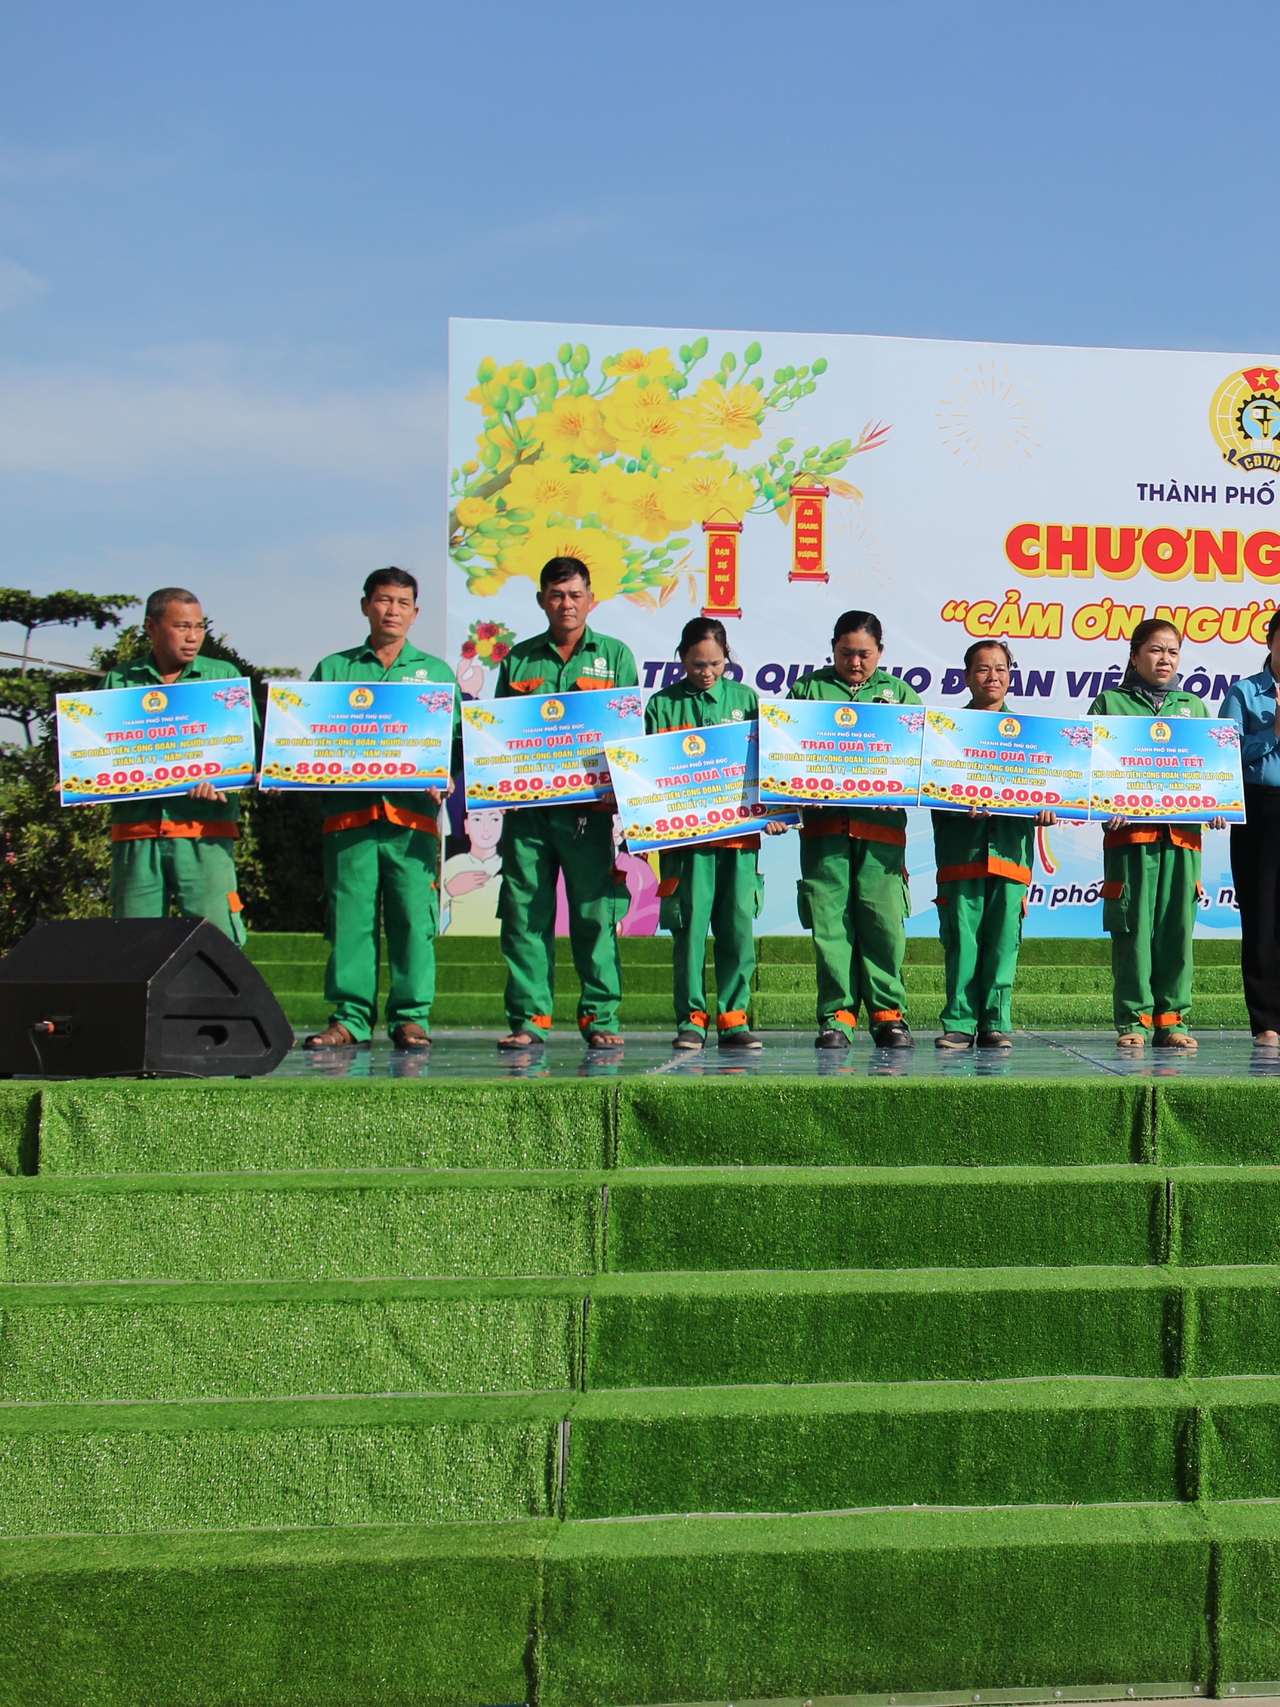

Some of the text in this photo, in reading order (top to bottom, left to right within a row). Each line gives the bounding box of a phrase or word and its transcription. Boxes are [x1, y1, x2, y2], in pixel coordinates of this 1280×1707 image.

[1244, 455, 1280, 470] CĐVN
[1136, 482, 1218, 505] THÀNH
[1225, 480, 1277, 506] PHỐ
[1072, 597, 1145, 641] ƠN
[643, 661, 744, 688] TRO
[941, 661, 1056, 697] ĐÀN
[1066, 664, 1125, 698] VIÊ
[105, 719, 207, 742] TRAO QUÀ TẾT
[309, 720, 409, 734] TRAO QUÀ TẾT
[506, 728, 602, 749] TRAO QUÀ TẾT
[800, 739, 892, 752] TRAO QUÀ TẾT
[183, 750, 203, 759] 2025
[963, 748, 1053, 764] TRAO QUÀ TẾT
[1120, 754, 1204, 767] TRAO QUÀ TẾT
[95, 761, 221, 787] 800.000Đ
[295, 762, 416, 775] 800.000Đ
[654, 761, 747, 788] TRAO QUÀ TẾT
[870, 767, 887, 775] 2025
[790, 777, 903, 792] 800.000Đ
[1028, 778, 1045, 786] 2025
[950, 783, 1060, 804] 800.000Đ
[1113, 794, 1216, 808] 800.000Đ
[653, 801, 767, 833] 800.000Đ
